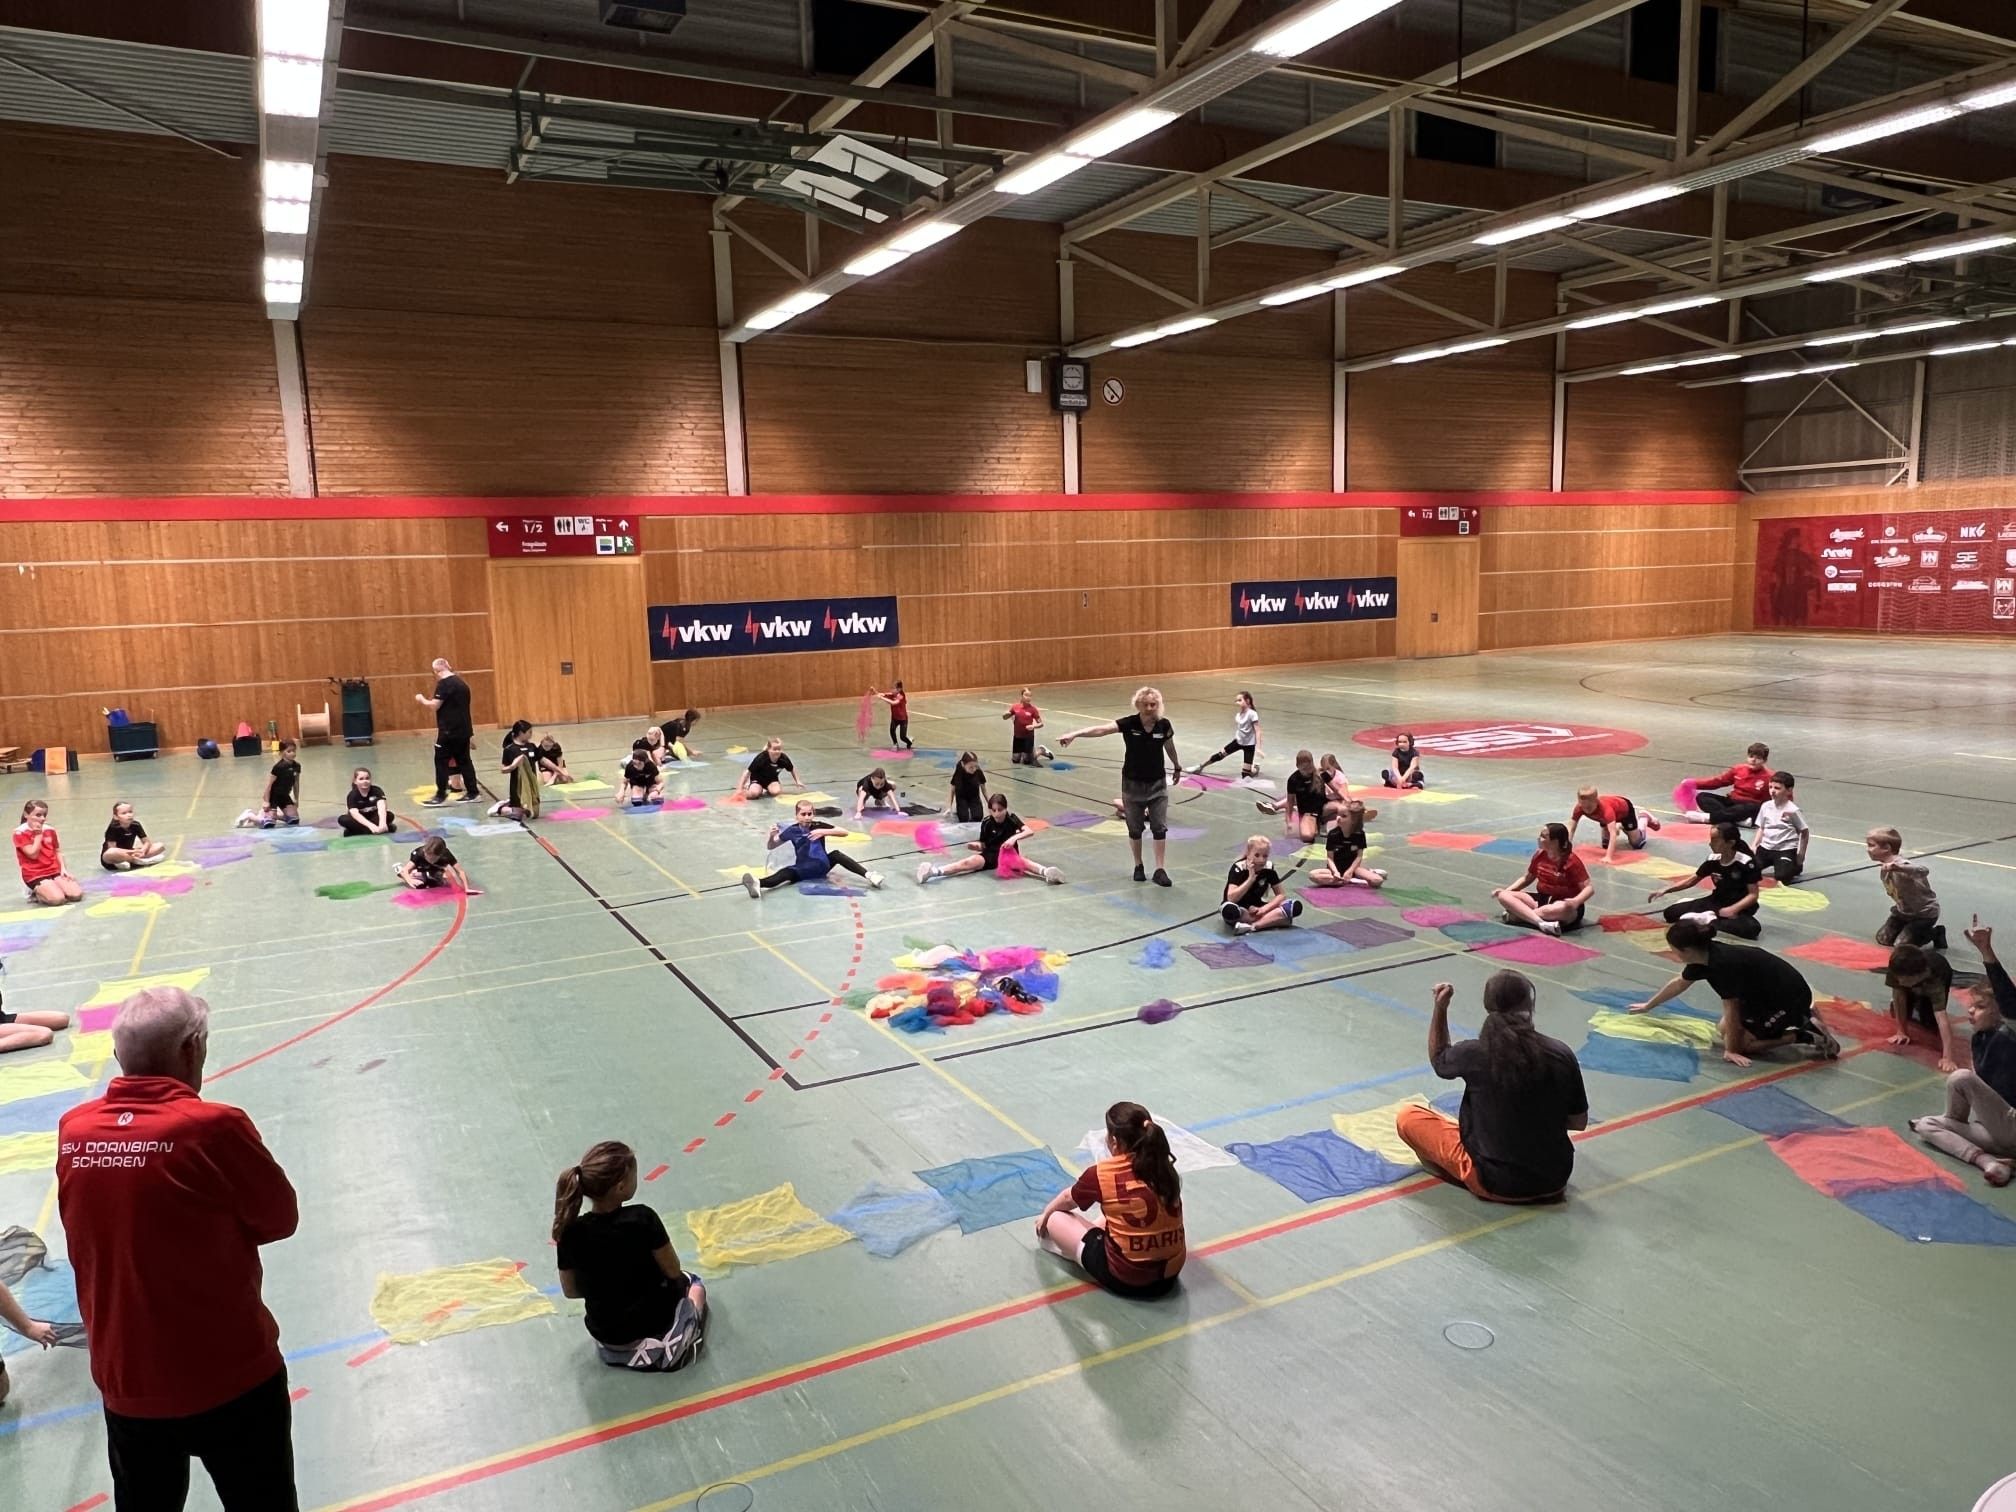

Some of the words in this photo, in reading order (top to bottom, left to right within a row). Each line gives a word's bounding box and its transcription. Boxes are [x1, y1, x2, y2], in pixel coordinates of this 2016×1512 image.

[524, 523, 543, 533] 1/2
[601, 523, 607, 532] 1
[1959, 522, 1986, 538] NKG
[1956, 551, 1979, 563] SE
[1250, 594, 1287, 613] vkw
[1304, 591, 1339, 610] vkw
[1355, 589, 1390, 608] vkw
[678, 619, 733, 643] vkw
[760, 615, 812, 639] vkw
[838, 611, 887, 634] vkw
[61, 1142, 81, 1155] SSV
[85, 1141, 174, 1153] DORNBIRN
[72, 1156, 146, 1168] SCHOREN
